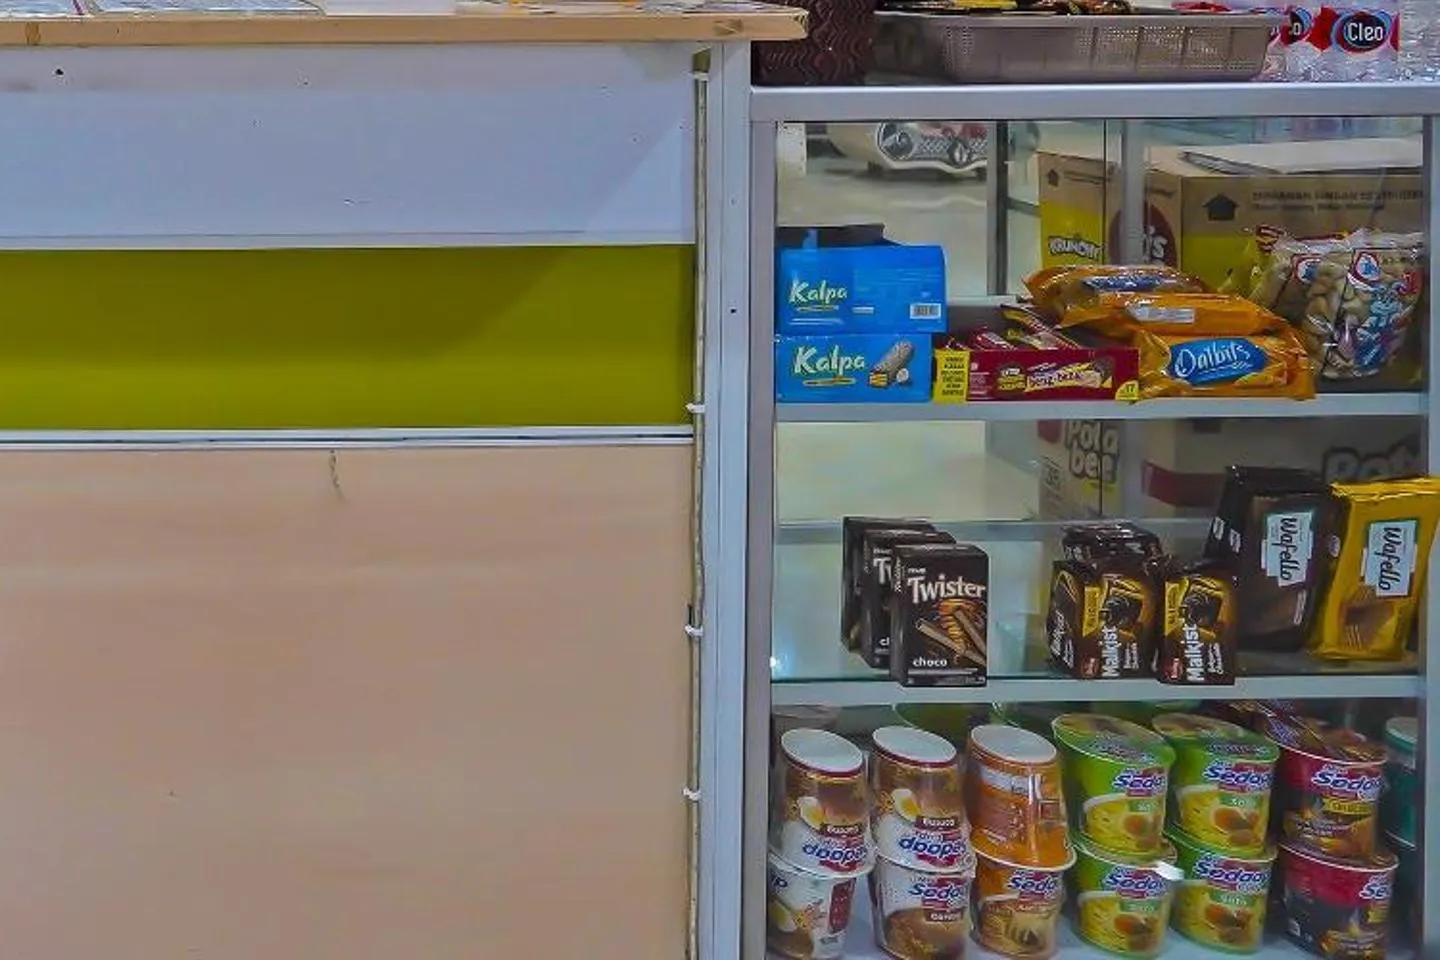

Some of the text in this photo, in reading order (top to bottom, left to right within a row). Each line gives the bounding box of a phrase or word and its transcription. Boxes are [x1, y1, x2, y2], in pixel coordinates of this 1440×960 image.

[1347, 22, 1384, 42] Cleo
[788, 279, 848, 304] Kalpa
[794, 344, 866, 375] Kalpa
[1272, 517, 1300, 581] Wafello
[1375, 527, 1402, 590] Wafello
[907, 573, 986, 604] Twister
[913, 656, 948, 668] choco
[1100, 626, 1121, 678] Malkist
[1181, 624, 1205, 682] Malkist
